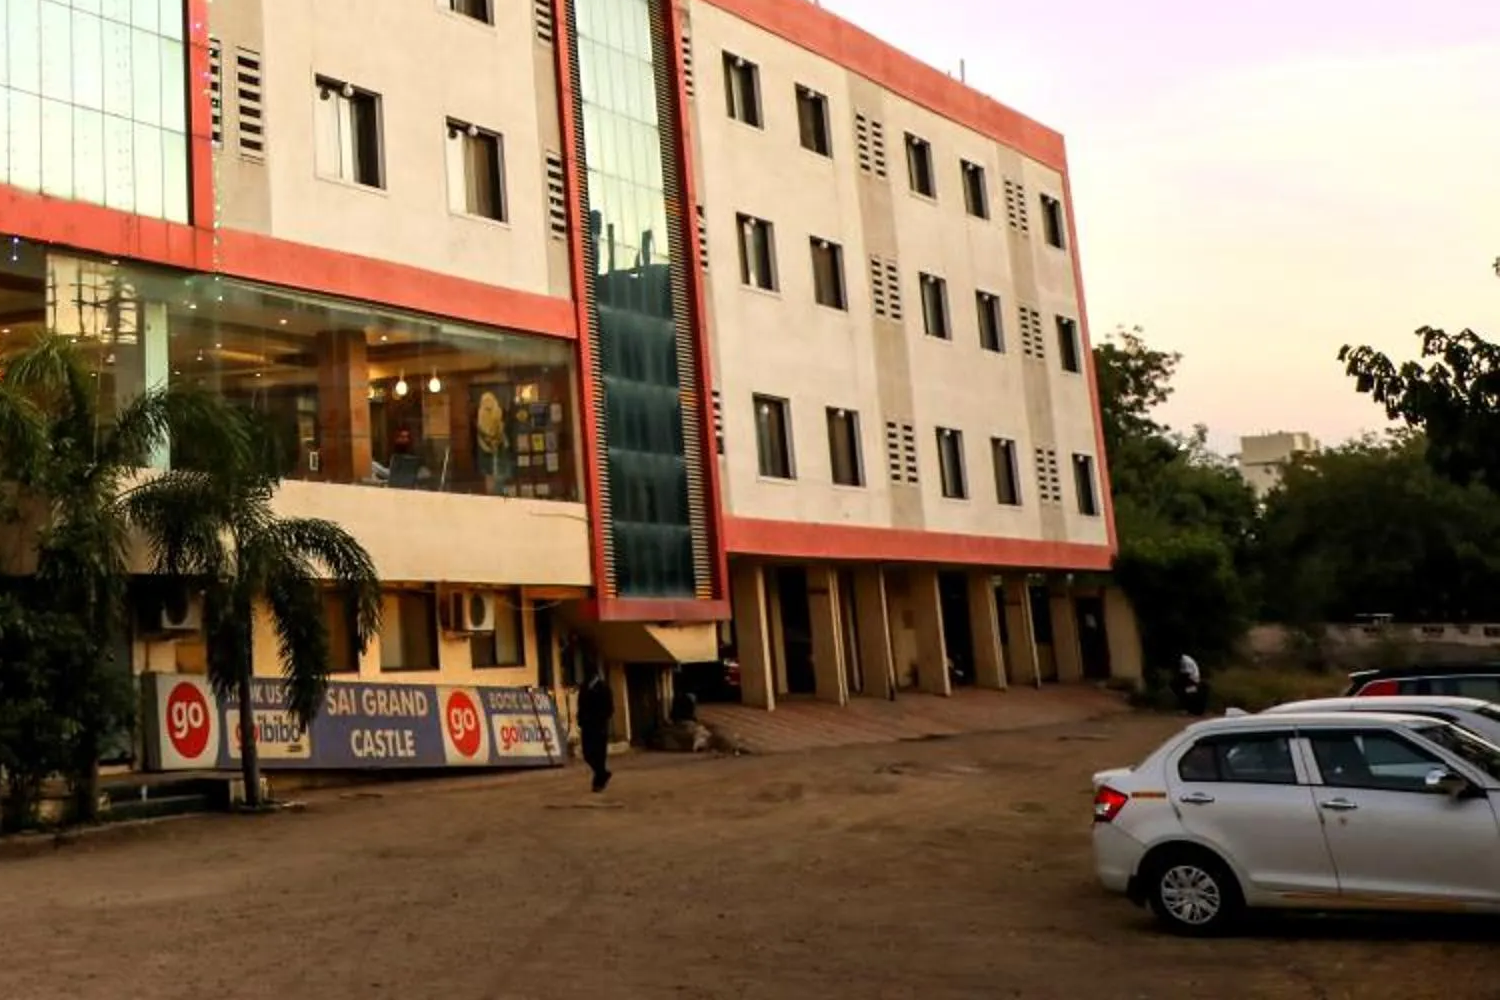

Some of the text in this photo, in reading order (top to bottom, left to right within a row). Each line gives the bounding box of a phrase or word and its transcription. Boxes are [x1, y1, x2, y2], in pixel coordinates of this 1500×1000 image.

[326, 687, 357, 717] SAI
[362, 687, 429, 717] GRAND
[171, 700, 204, 739] go
[450, 707, 476, 740] go
[235, 721, 301, 749] ibibo
[351, 729, 416, 757] CASTLE
